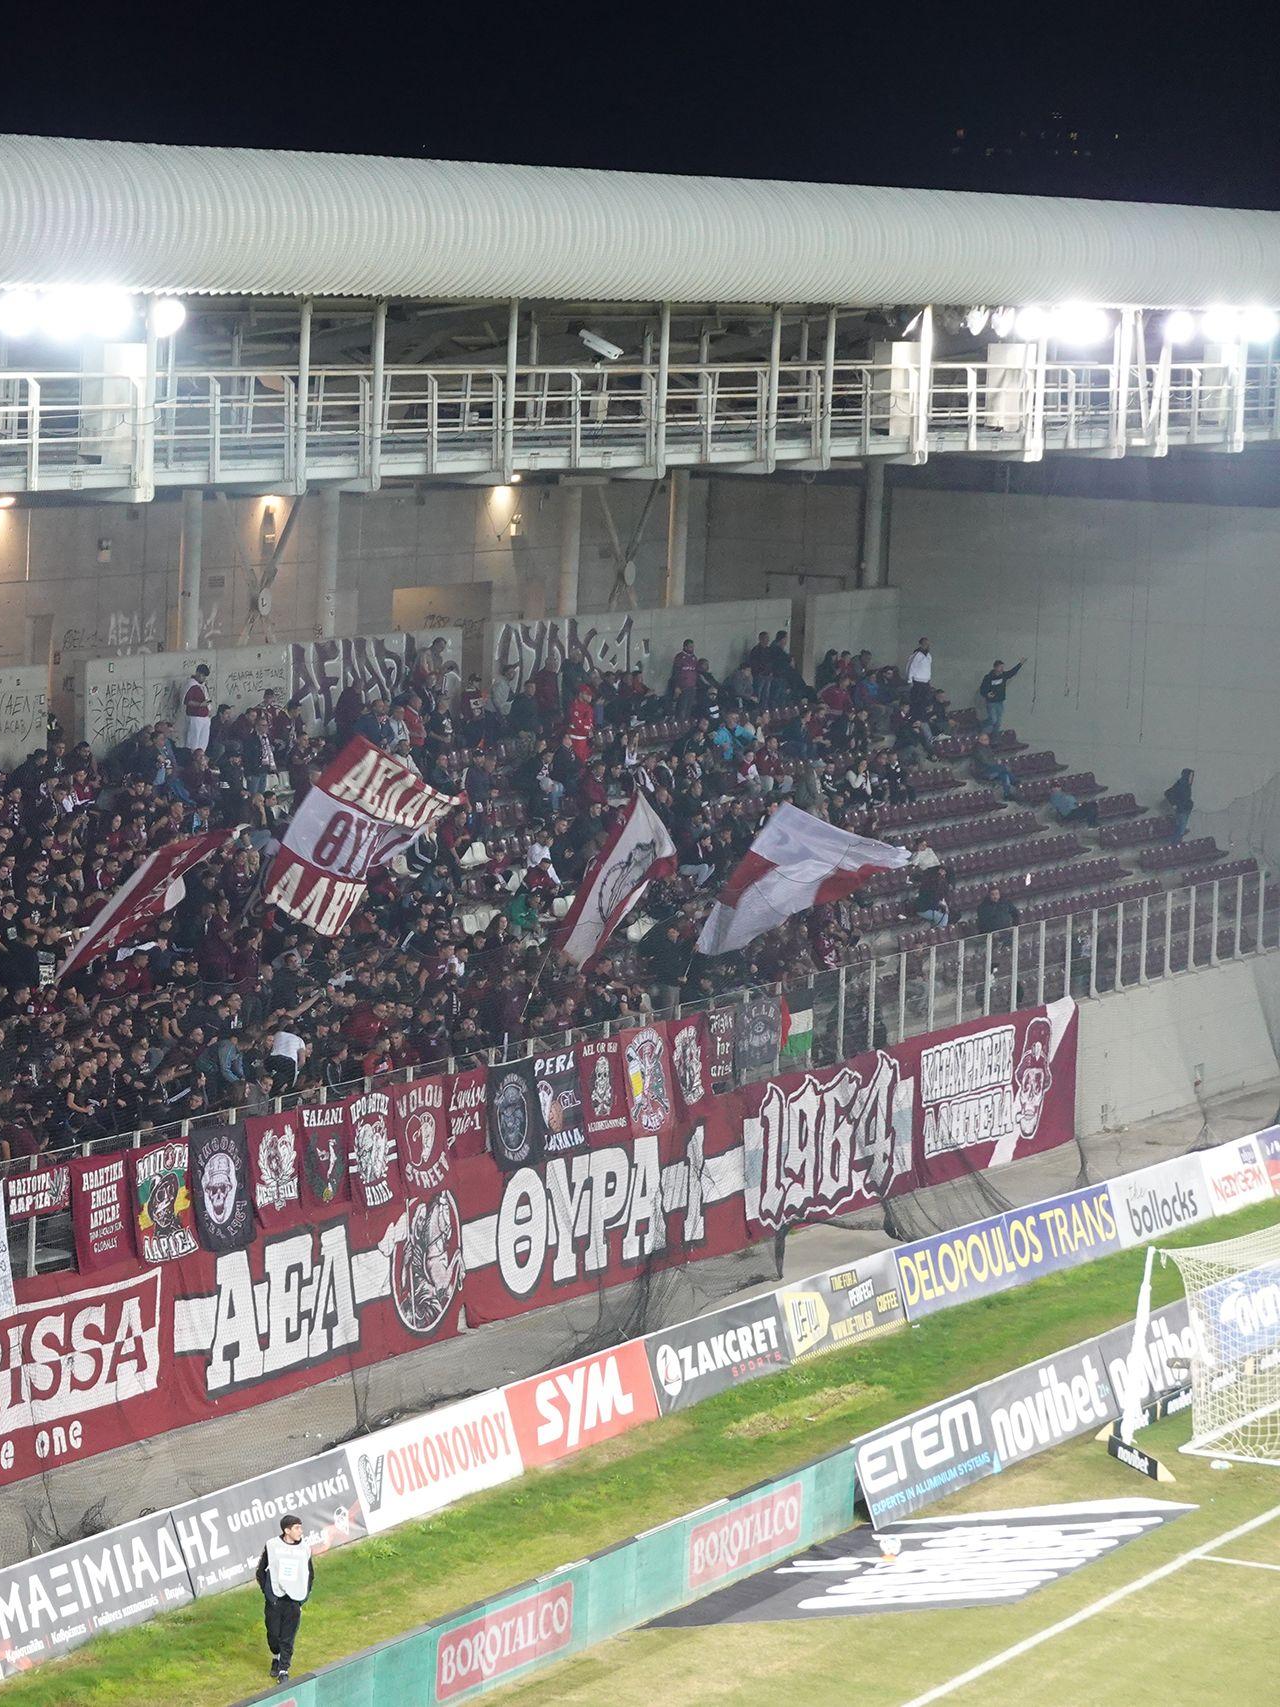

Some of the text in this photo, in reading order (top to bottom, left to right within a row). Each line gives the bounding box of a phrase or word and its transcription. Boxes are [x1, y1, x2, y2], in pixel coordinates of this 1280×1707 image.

[302, 1107, 344, 1127] FALANI
[397, 1085, 442, 1118] VOLOU
[924, 1088, 1014, 1157] ΑΛΗΤΕΙΑ
[760, 1053, 898, 1224] 1964
[8, 1172, 51, 1197] ΜΑΣΤΟΥΡΑ
[82, 1160, 124, 1191] ΑΘΛΗΤΙΚΗ
[91, 1184, 118, 1209] ΕΝΩΣΗ
[405, 1151, 449, 1188] STREET
[9, 1191, 51, 1216] ΛΑΡΙΣΑ
[1126, 1182, 1199, 1238] bollocks
[898, 1193, 1117, 1305] DELOPOULOS TRANS
[206, 1223, 361, 1391] ΑΕΛ
[848, 1279, 874, 1308] PERFECT
[876, 1291, 899, 1313] COFFEE
[679, 1316, 779, 1381] ZAKCRET
[732, 1351, 782, 1377] SPORTS
[535, 1355, 634, 1447] SYM
[991, 1354, 1108, 1462] novibet
[35, 1420, 82, 1458] one
[857, 1399, 983, 1495] ETEM
[226, 1468, 350, 1532] υαλοτεχνική
[871, 1450, 992, 1516] EXPERTS IN ALUMINIUM SYSTEMS
[693, 1494, 799, 1575] BOROTALCO
[441, 1596, 569, 1686] BOROTALCO
